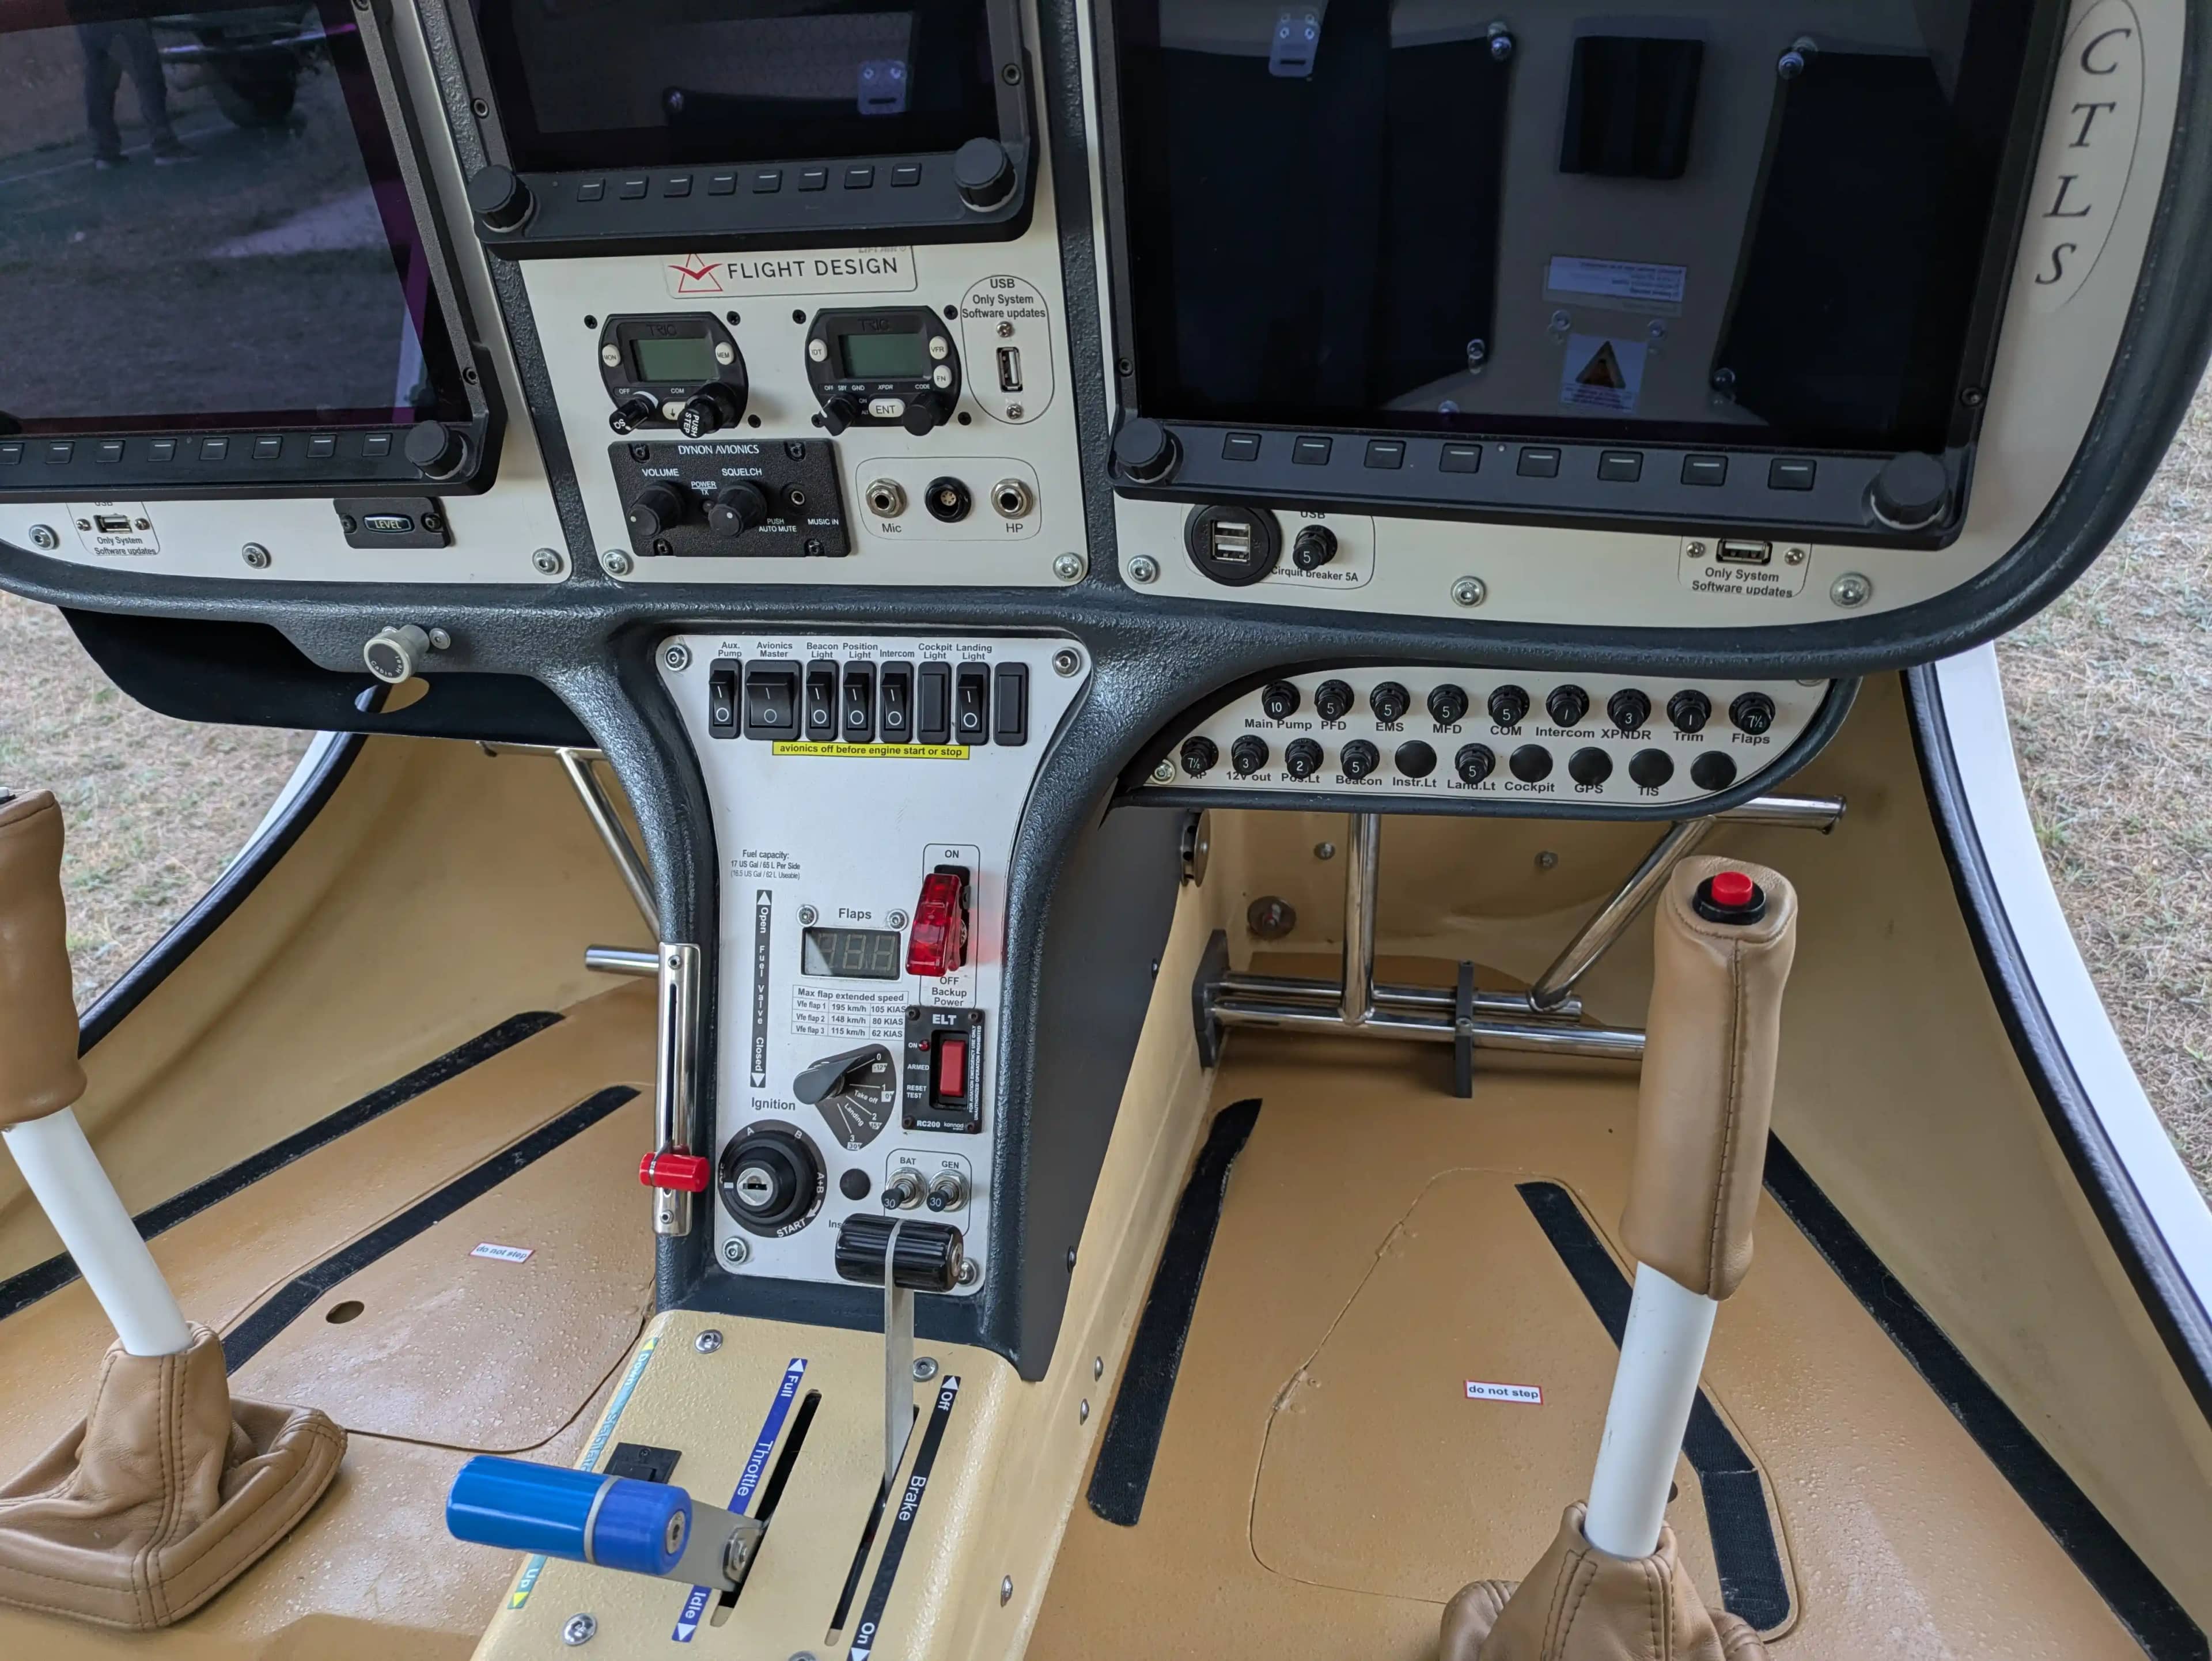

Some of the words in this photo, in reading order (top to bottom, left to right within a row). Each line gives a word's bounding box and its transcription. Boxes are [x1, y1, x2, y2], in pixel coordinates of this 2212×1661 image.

[2035, 28, 2132, 285] CTLS
[728, 260, 805, 279] FLIGHT
[814, 257, 897, 276] DESIGN
[990, 278, 1015, 288] USB
[972, 294, 995, 306] Only
[998, 294, 1033, 306] System
[962, 308, 1004, 318] Software
[1007, 309, 1046, 320] updates
[876, 406, 895, 414] ENT
[678, 445, 714, 455] DYNON
[715, 445, 759, 454] AVIONICS
[642, 468, 680, 476] VOLUME
[721, 468, 762, 476] SQUELCH
[375, 519, 402, 529] LEVEL
[882, 523, 902, 533] Mic
[1006, 523, 1023, 533] HP
[97, 536, 113, 546] Only
[115, 536, 143, 546] System
[94, 547, 126, 555] Software
[127, 547, 156, 557] updates
[1303, 551, 1311, 564] 5
[1306, 569, 1343, 581] breaker
[1345, 572, 1358, 582] 5A
[1705, 567, 1732, 580] Only
[1736, 569, 1779, 582] System
[1692, 581, 1743, 593] Software
[1746, 584, 1793, 598] updates
[722, 641, 740, 649] Aux.
[756, 641, 793, 649] Avionics
[806, 642, 838, 650] Beacon
[843, 642, 878, 650] Position
[918, 643, 952, 653] Cockpit
[956, 644, 993, 653] Landing
[718, 650, 742, 659] Pump
[760, 650, 788, 658] Master
[811, 650, 833, 660] Light
[849, 651, 871, 660] Light
[880, 650, 915, 658] Intercom
[923, 652, 946, 660] Light
[962, 652, 985, 661] Light
[370, 661, 393, 677] Cabin
[1271, 702, 1282, 713] 10
[1327, 703, 1334, 714] 5
[1384, 705, 1392, 716] 5
[1442, 706, 1449, 718] 5
[1502, 709, 1510, 720] 5
[1625, 713, 1632, 724] 3
[1244, 718, 1272, 729] Main
[1277, 719, 1312, 731] Pump
[1321, 721, 1347, 730] PFD
[1376, 722, 1404, 732] EMS
[1433, 724, 1462, 734] MFD
[1490, 726, 1522, 736] COM
[1536, 727, 1594, 738] Intercom
[1601, 729, 1652, 740] XPNDR
[1673, 732, 1703, 741] Trim
[1732, 733, 1770, 746] Flaps
[779, 744, 818, 752] avionics
[821, 745, 834, 753] off
[836, 746, 866, 754] before
[869, 747, 901, 756] engine
[903, 747, 926, 755] start
[941, 748, 962, 758] stop
[1242, 758, 1249, 769] 3
[1296, 760, 1303, 771] 2
[1352, 762, 1359, 773] 5
[1469, 766, 1476, 777] 5
[1336, 775, 1382, 785] Beacon
[1392, 777, 1437, 788] Instr.Lt
[1504, 782, 1555, 793] Cockpit
[1574, 784, 1603, 793] GPS
[743, 850, 757, 858] Fuel
[759, 851, 789, 861] capacity:
[945, 850, 959, 858] ON
[838, 908, 872, 921] Flaps
[760, 907, 768, 933] Open
[940, 977, 959, 985] OFF
[798, 988, 815, 997] Max
[817, 990, 833, 1000] flap
[835, 992, 875, 1001] extended
[877, 993, 904, 1003] speed
[931, 987, 967, 997] Backup
[809, 1001, 821, 1010] flap
[934, 997, 964, 1007] Power
[808, 1014, 820, 1022] flap
[932, 1014, 956, 1025] ELT
[807, 1026, 819, 1034] flap
[846, 1028, 865, 1036] km/h
[755, 1037, 764, 1072] Closed
[751, 1097, 796, 1110] Ignition
[900, 1157, 916, 1165] BAT
[942, 1160, 959, 1169] GEN
[884, 1198, 895, 1208] 30
[930, 1197, 941, 1207] 30
[777, 1218, 806, 1238] START
[507, 1250, 527, 1259] step
[623, 1353, 648, 1387] Down
[781, 1374, 799, 1397] Full
[1469, 1385, 1484, 1393] do
[1488, 1387, 1508, 1396] not
[1512, 1389, 1539, 1399] step
[938, 1391, 953, 1412] Off
[737, 1440, 774, 1497] Throttle
[899, 1475, 927, 1521] Brake
[685, 1591, 706, 1619] Idle
[857, 1622, 876, 1645] On
